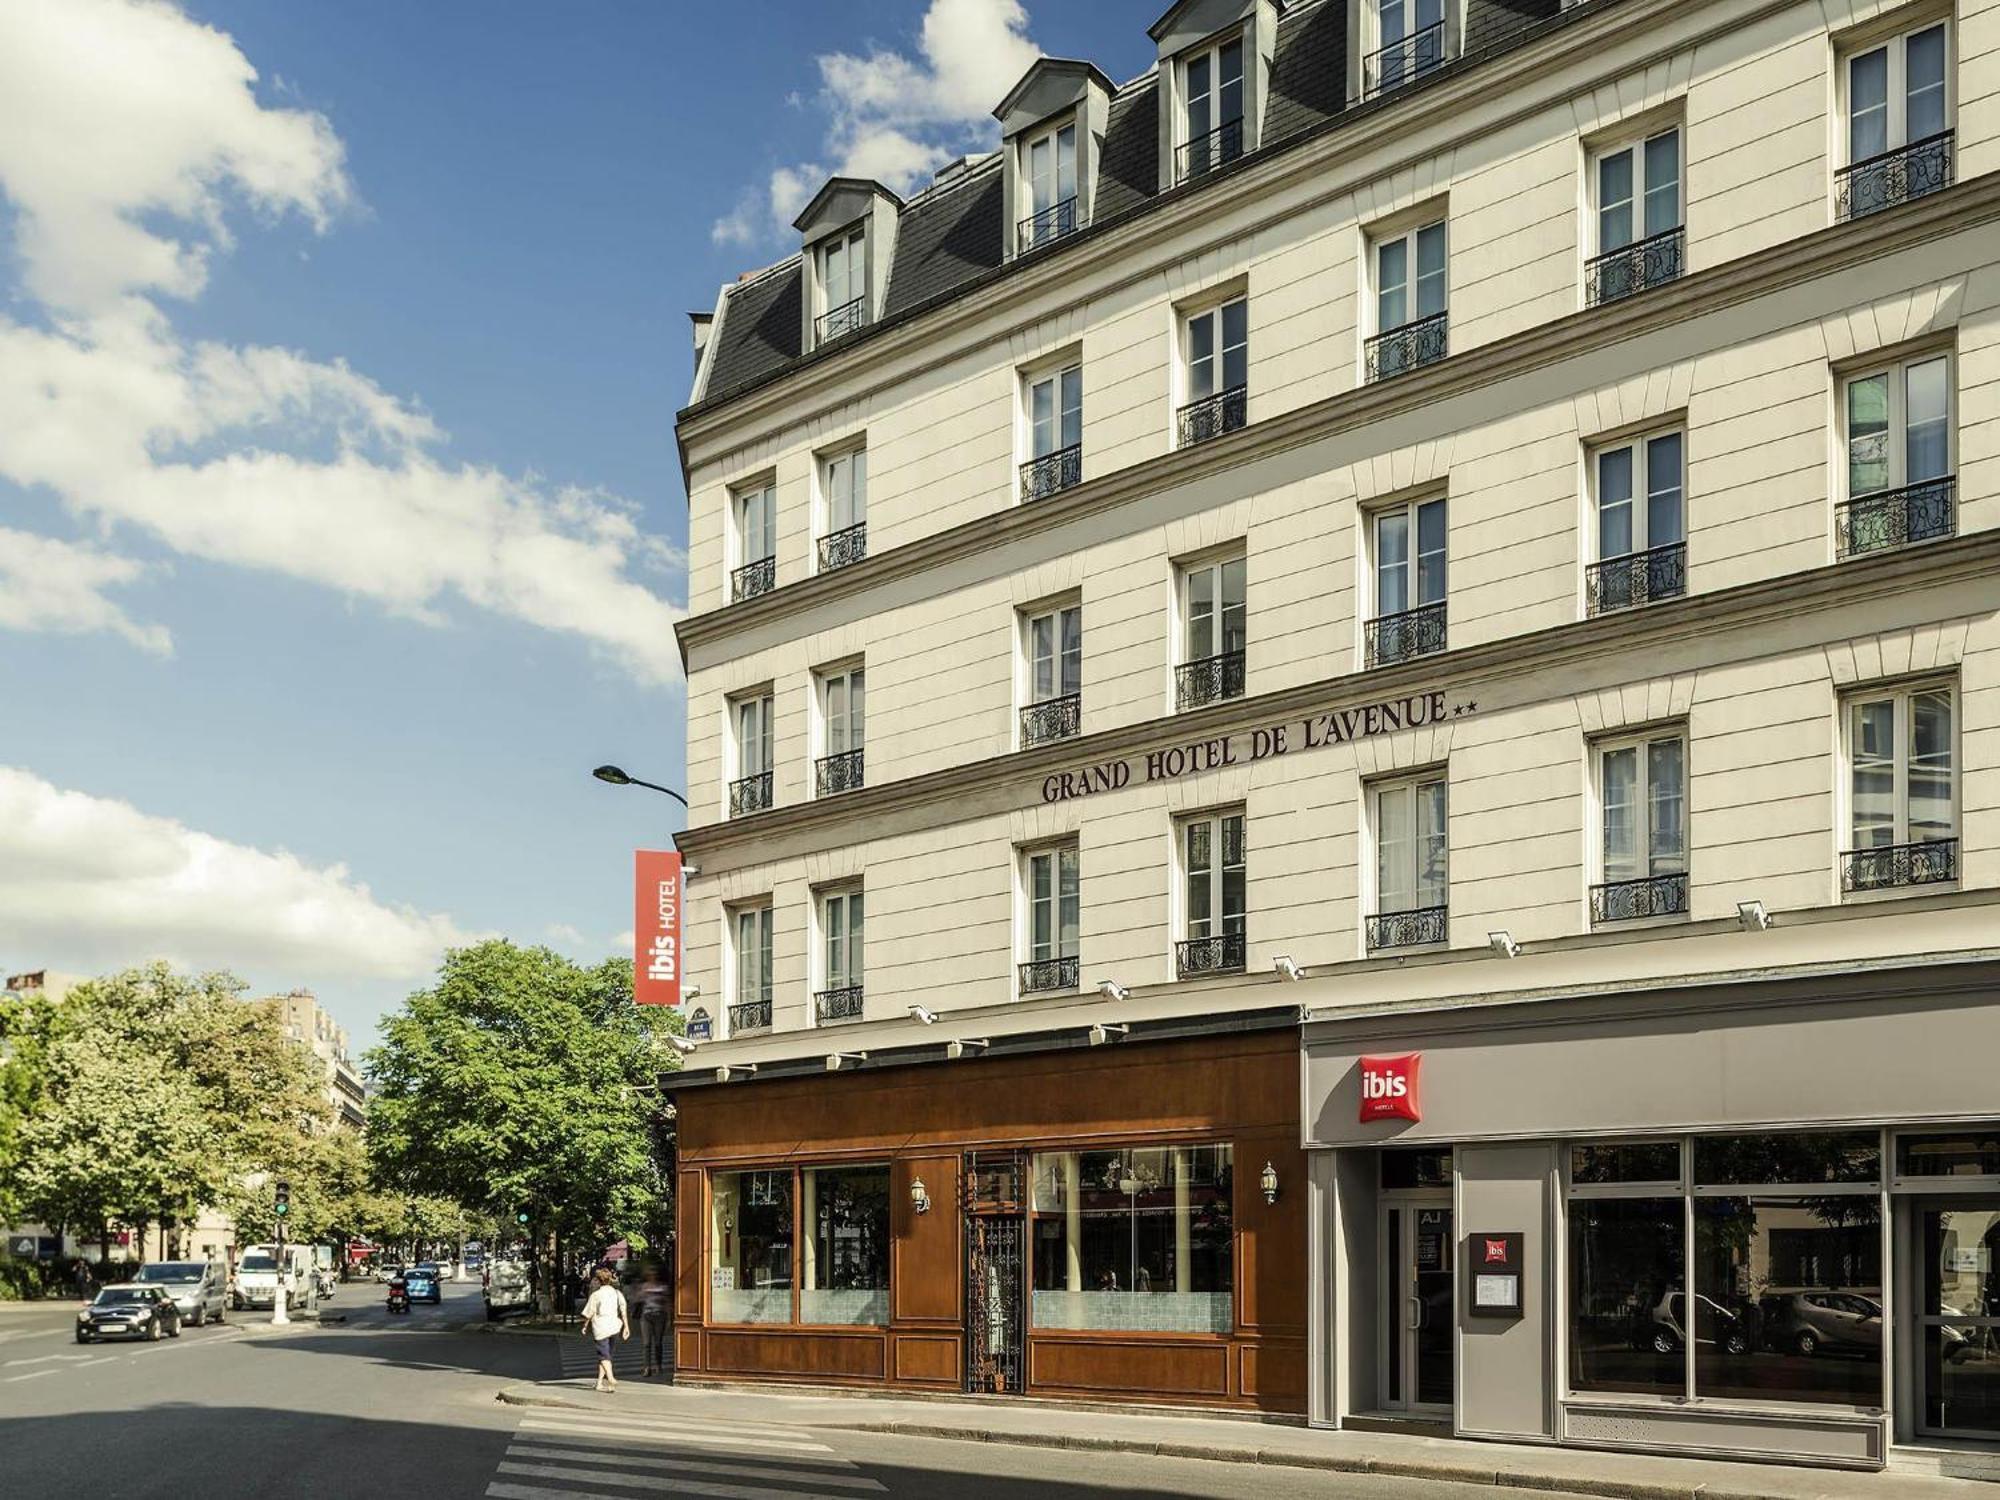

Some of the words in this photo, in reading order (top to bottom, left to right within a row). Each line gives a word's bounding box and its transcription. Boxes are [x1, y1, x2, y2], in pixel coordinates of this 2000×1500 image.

[1043, 760, 1130, 803] GRAND
[1146, 737, 1236, 783] HOTEL
[1251, 725, 1287, 760] DE
[1303, 690, 1448, 749] L'AVENUE
[660, 876, 676, 929] HOTEL
[649, 935, 675, 981] ibis
[1363, 1070, 1407, 1099] ibis
[1488, 1246, 1504, 1256] ibis
